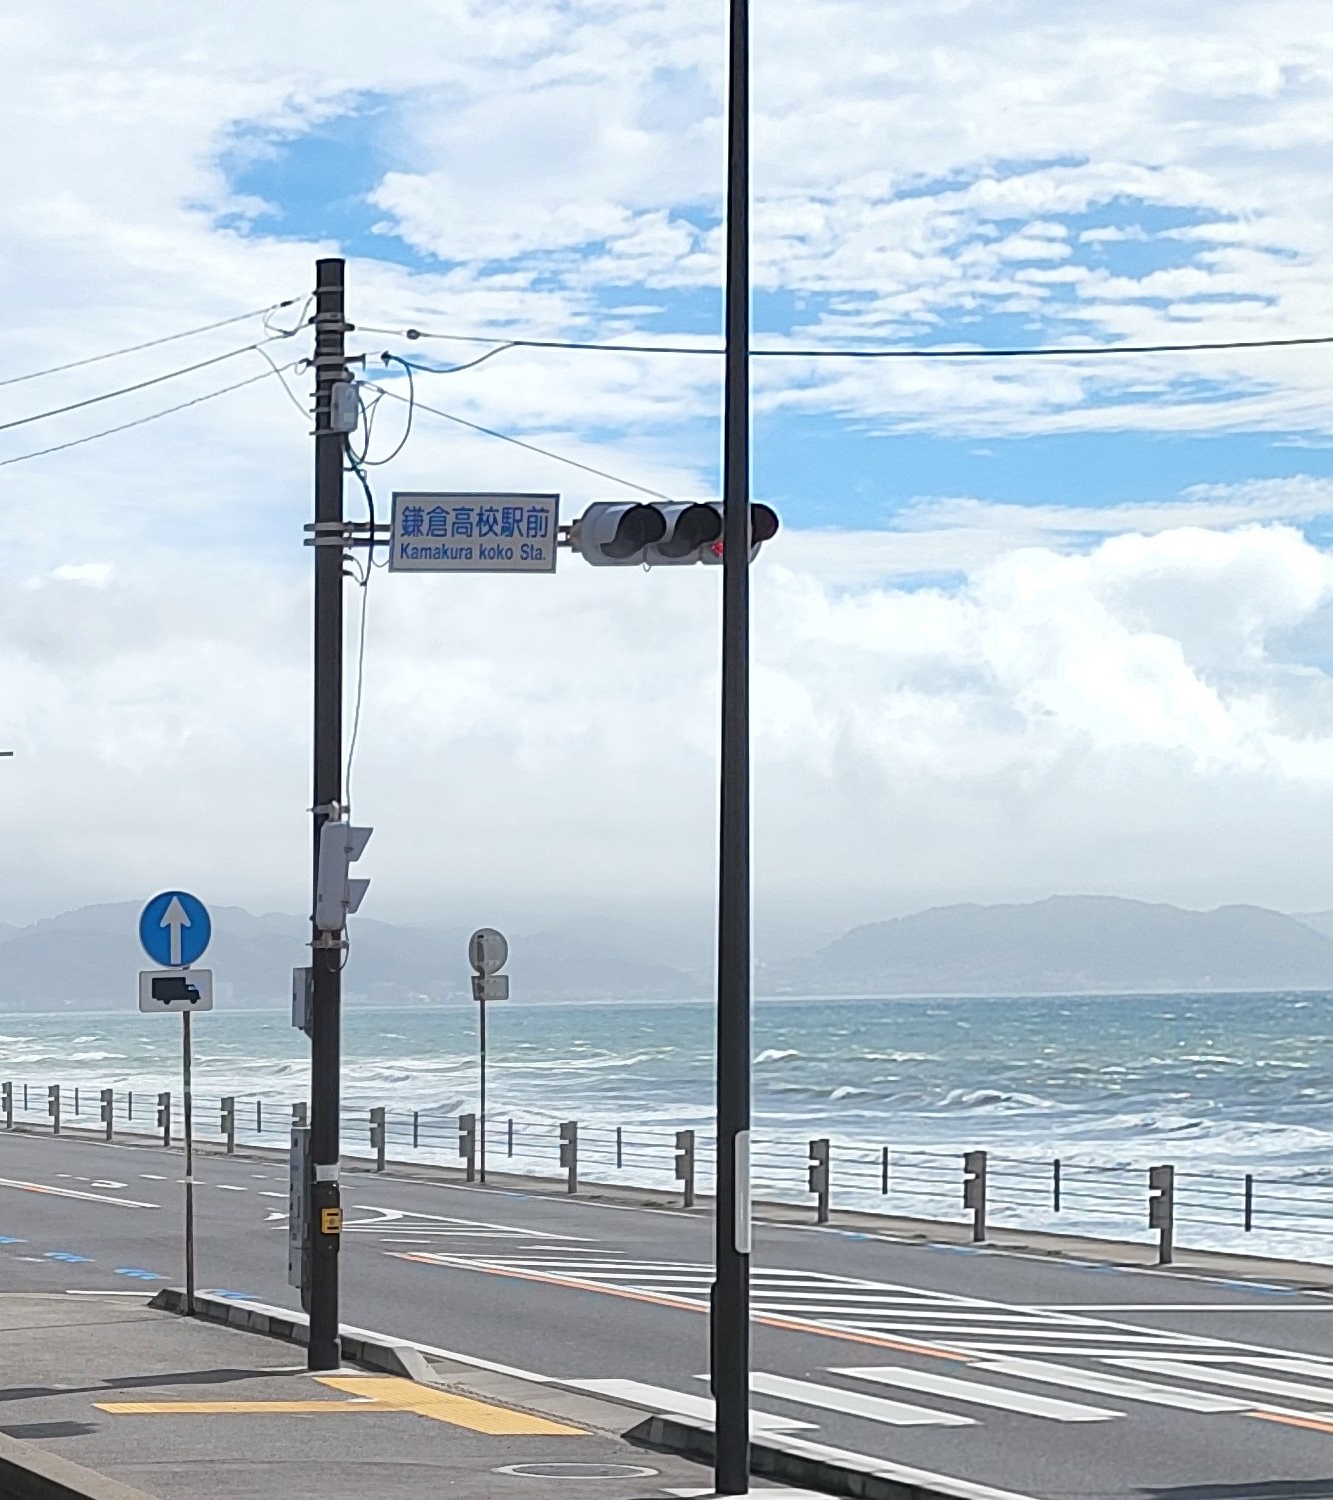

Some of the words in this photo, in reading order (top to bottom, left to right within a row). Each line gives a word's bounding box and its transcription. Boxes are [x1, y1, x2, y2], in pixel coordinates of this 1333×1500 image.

[400, 505, 550, 538] 鎌倉高校駅前
[400, 542, 473, 560] Kamakura
[479, 543, 513, 560] koko
[520, 543, 546, 561] Sta.
